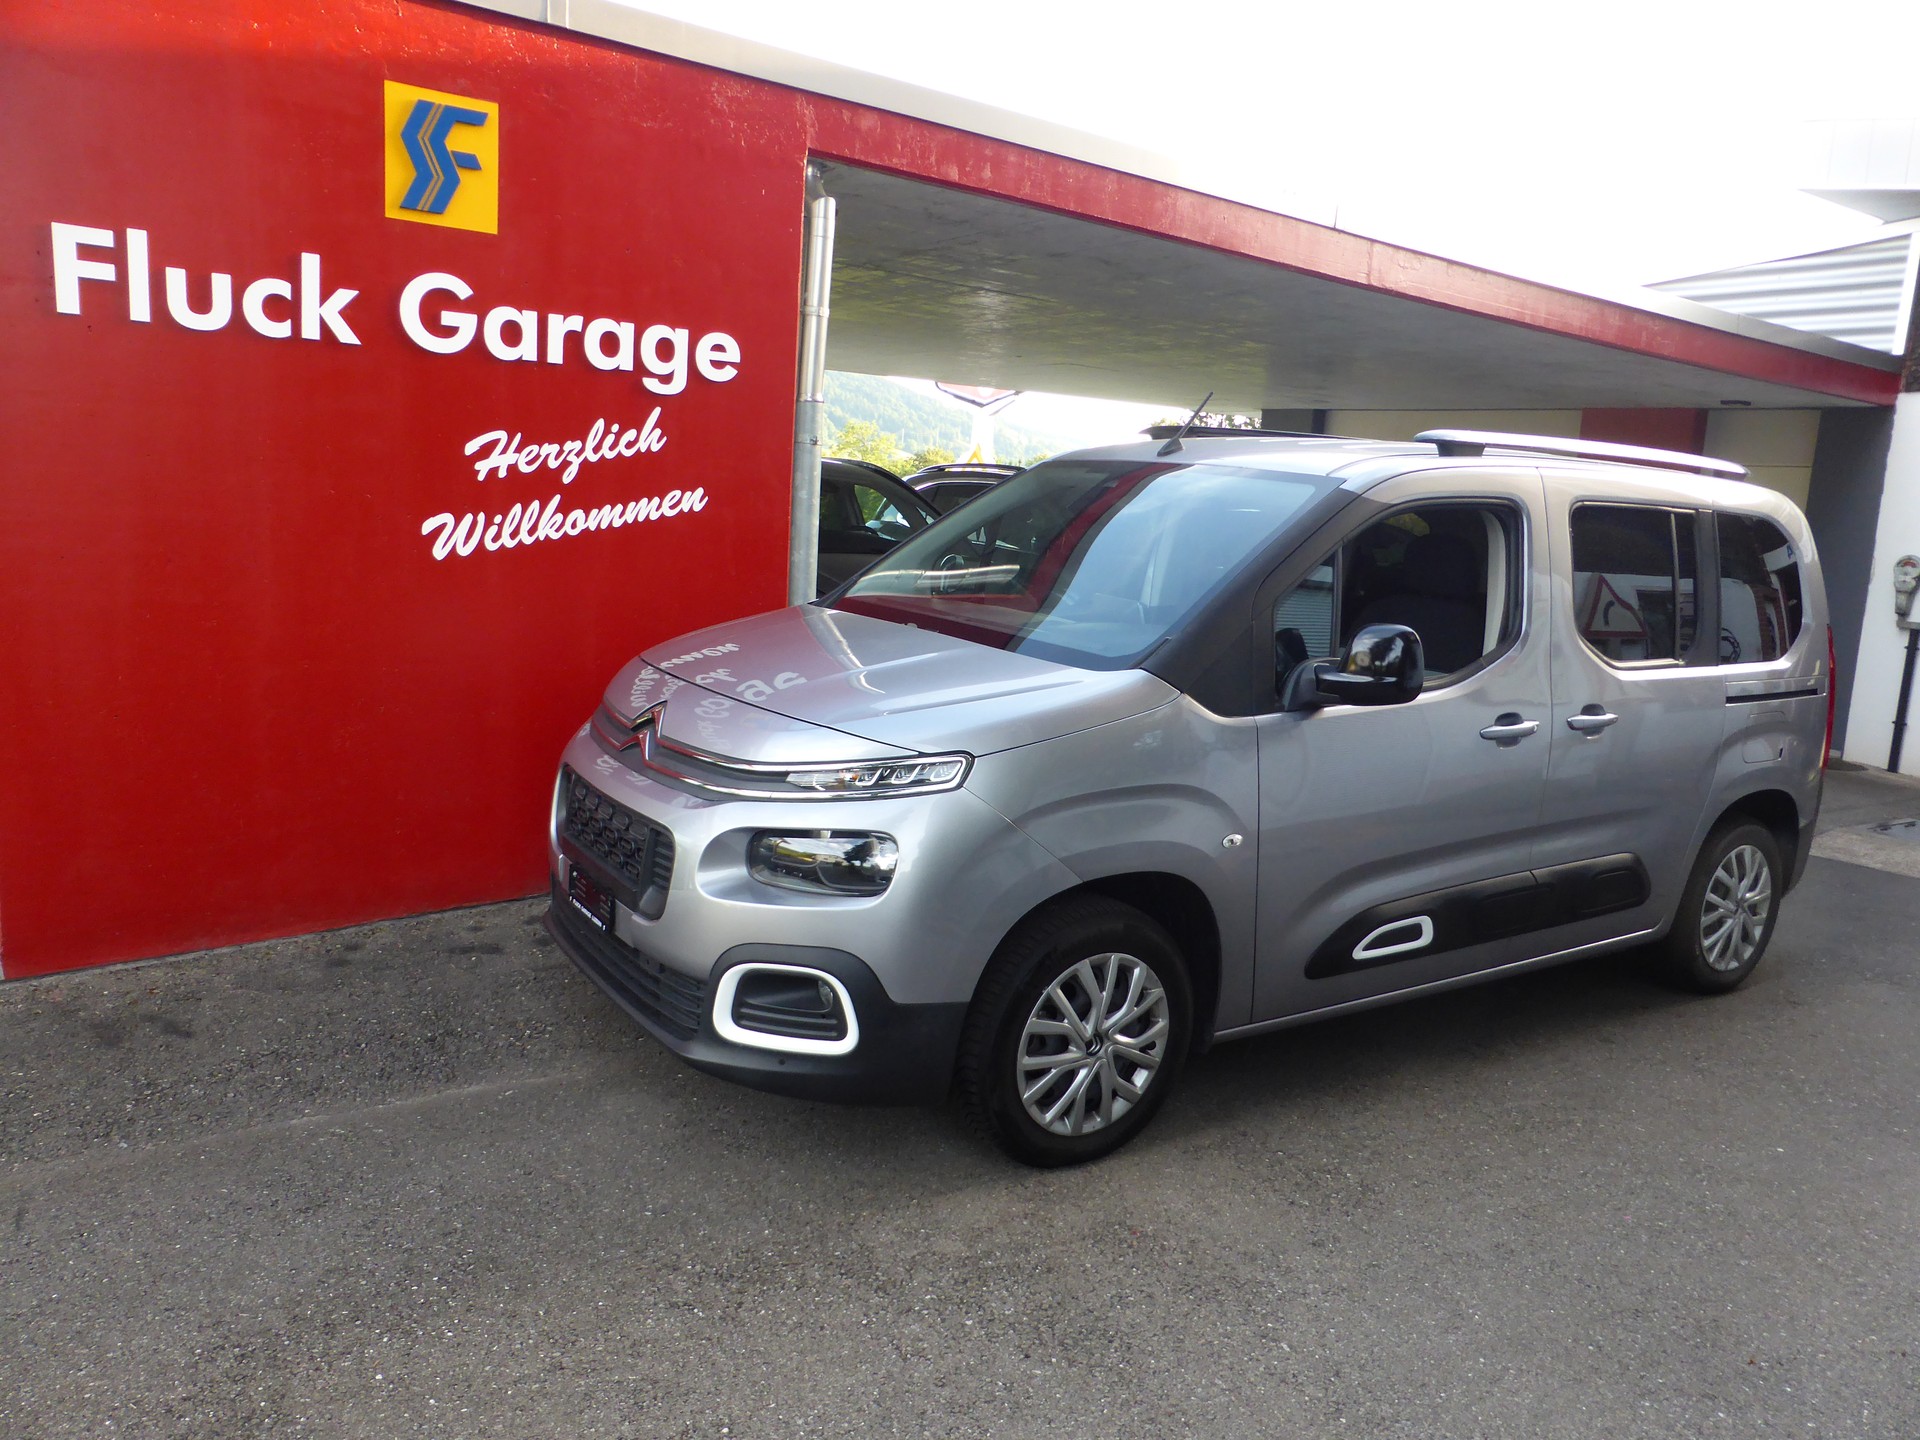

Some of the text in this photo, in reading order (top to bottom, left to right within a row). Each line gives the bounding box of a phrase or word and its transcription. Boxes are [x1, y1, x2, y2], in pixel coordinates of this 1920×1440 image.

[51, 222, 741, 396] Fluck Garage
[464, 407, 667, 484] Herzlich
[421, 487, 709, 561] Willkommen
